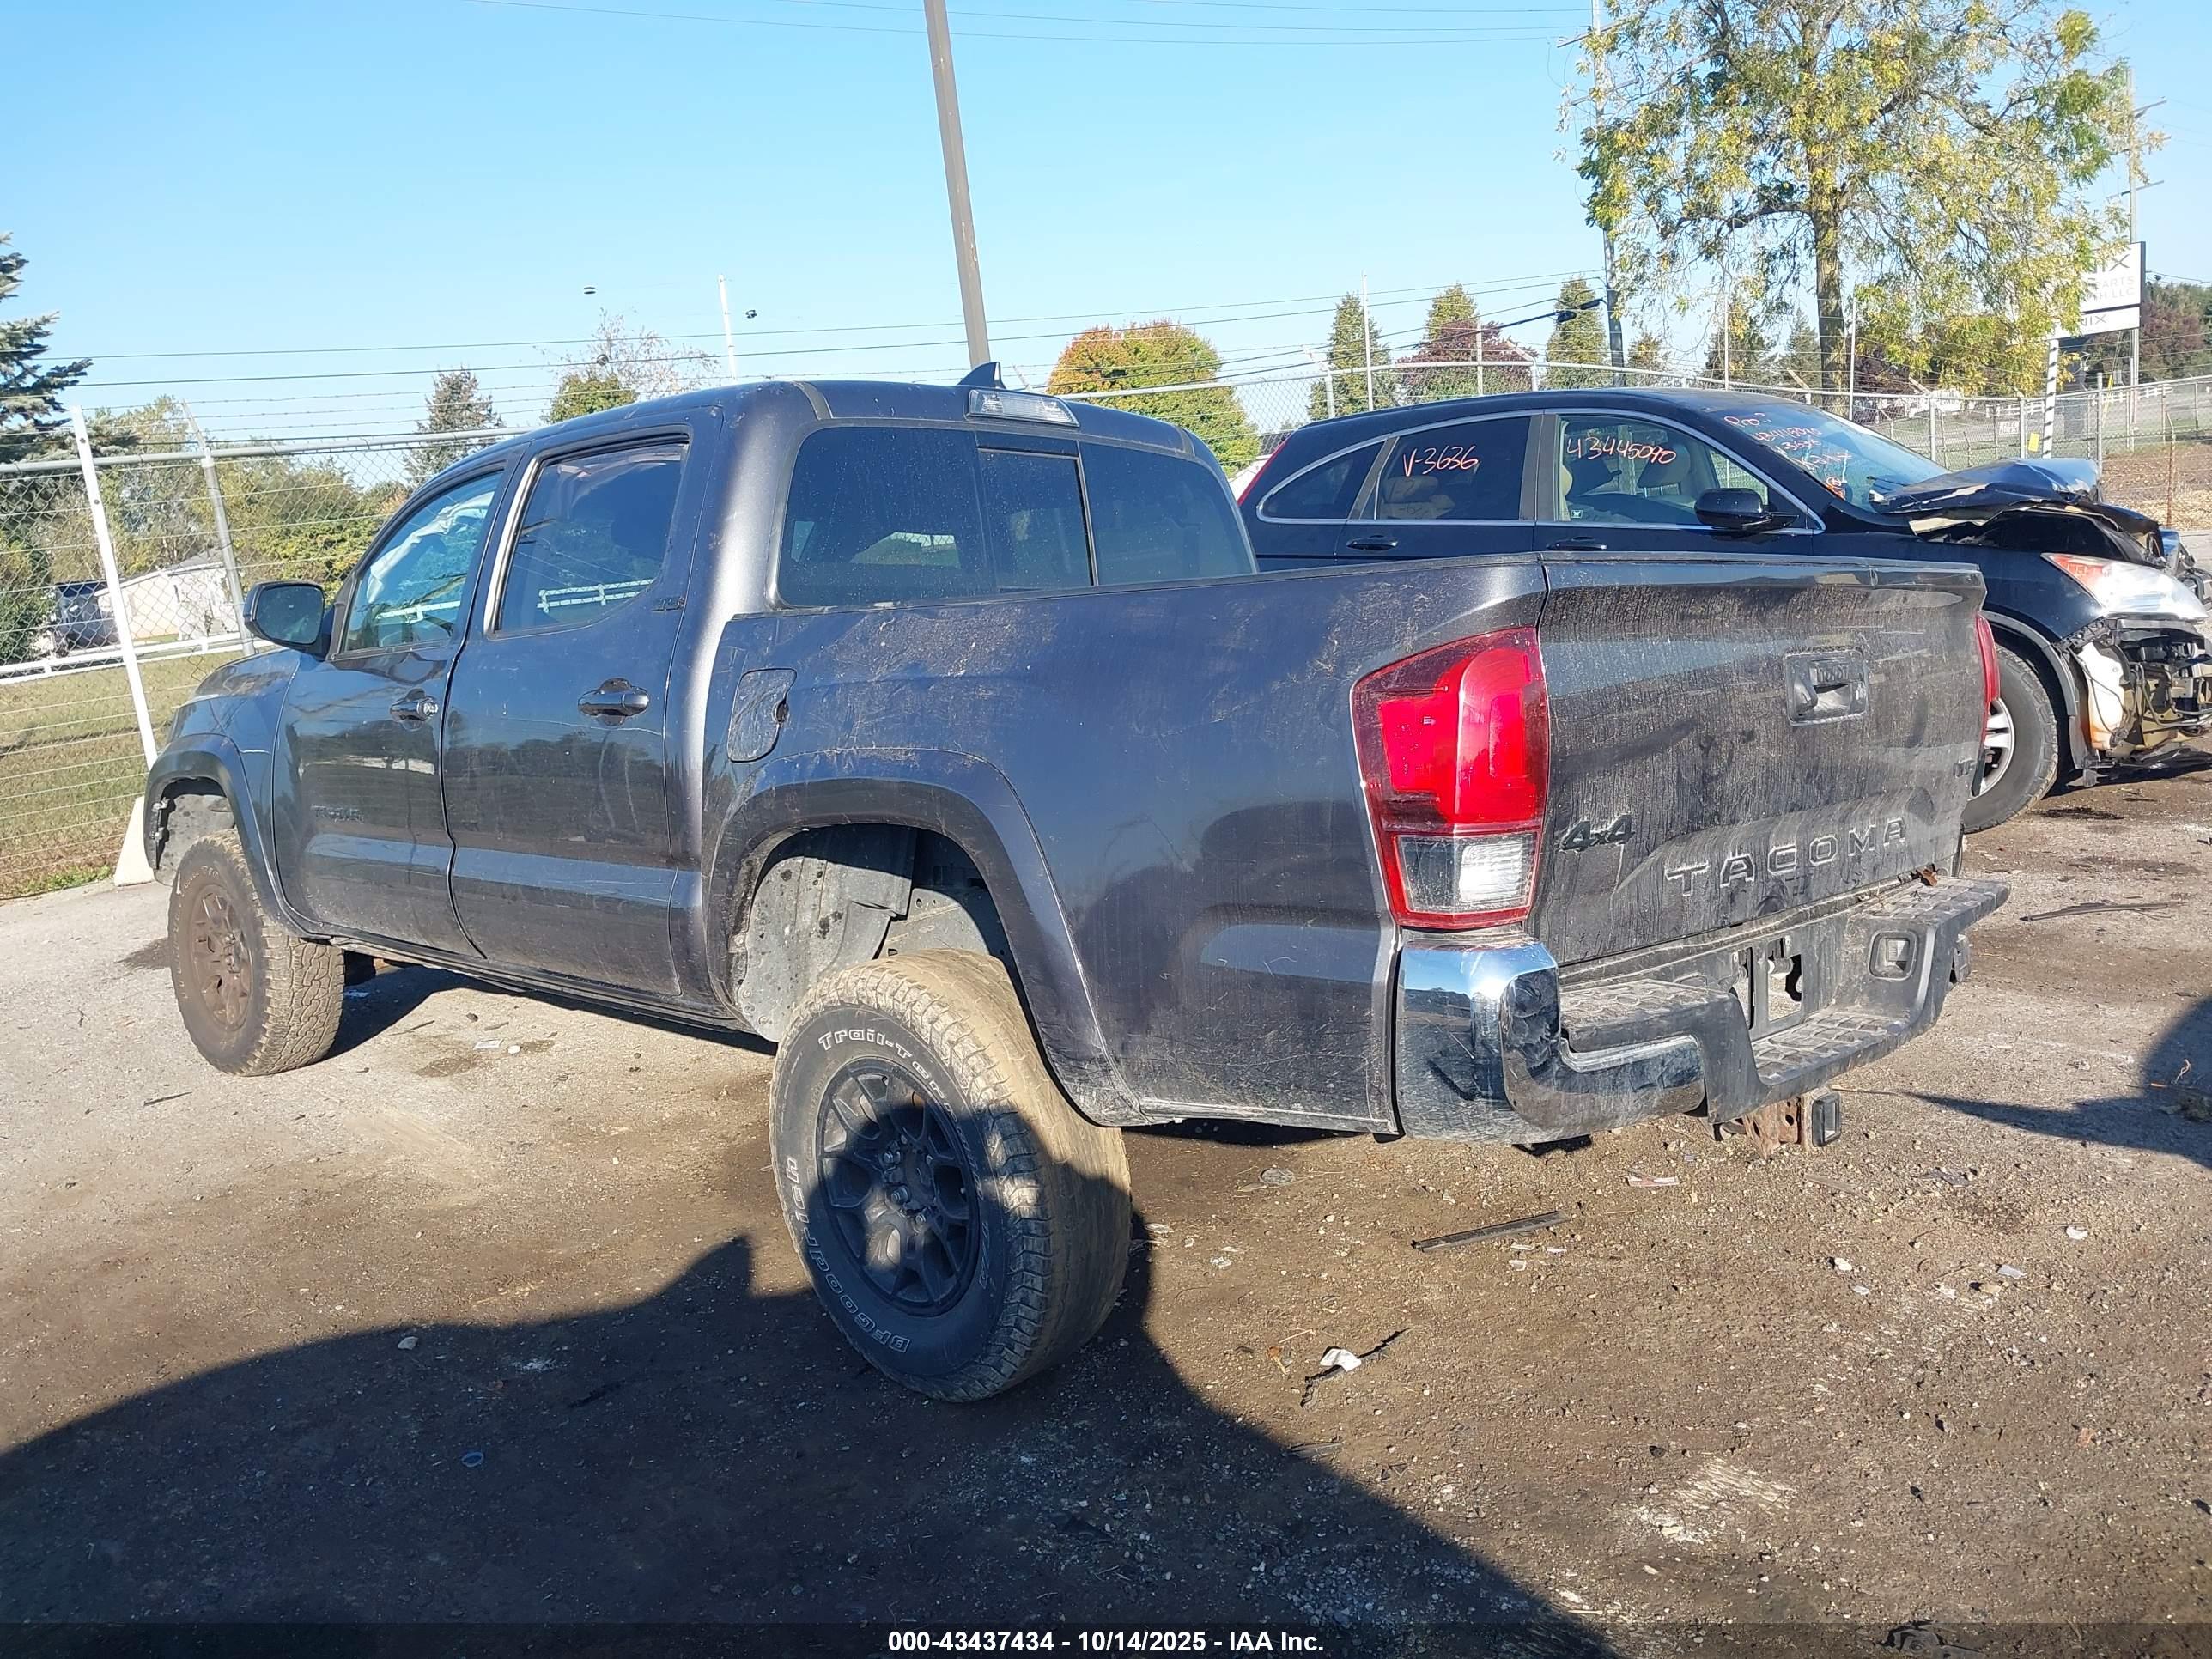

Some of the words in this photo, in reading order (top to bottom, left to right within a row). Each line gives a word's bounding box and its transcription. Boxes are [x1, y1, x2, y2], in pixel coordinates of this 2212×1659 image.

[1403, 446, 1479, 477] V-3636
[1567, 435, 1677, 464] 43445090
[1561, 813, 1635, 852] 4x4
[1664, 816, 1905, 896] TACOMA
[786, 1156, 911, 1353] BFGoodrich
